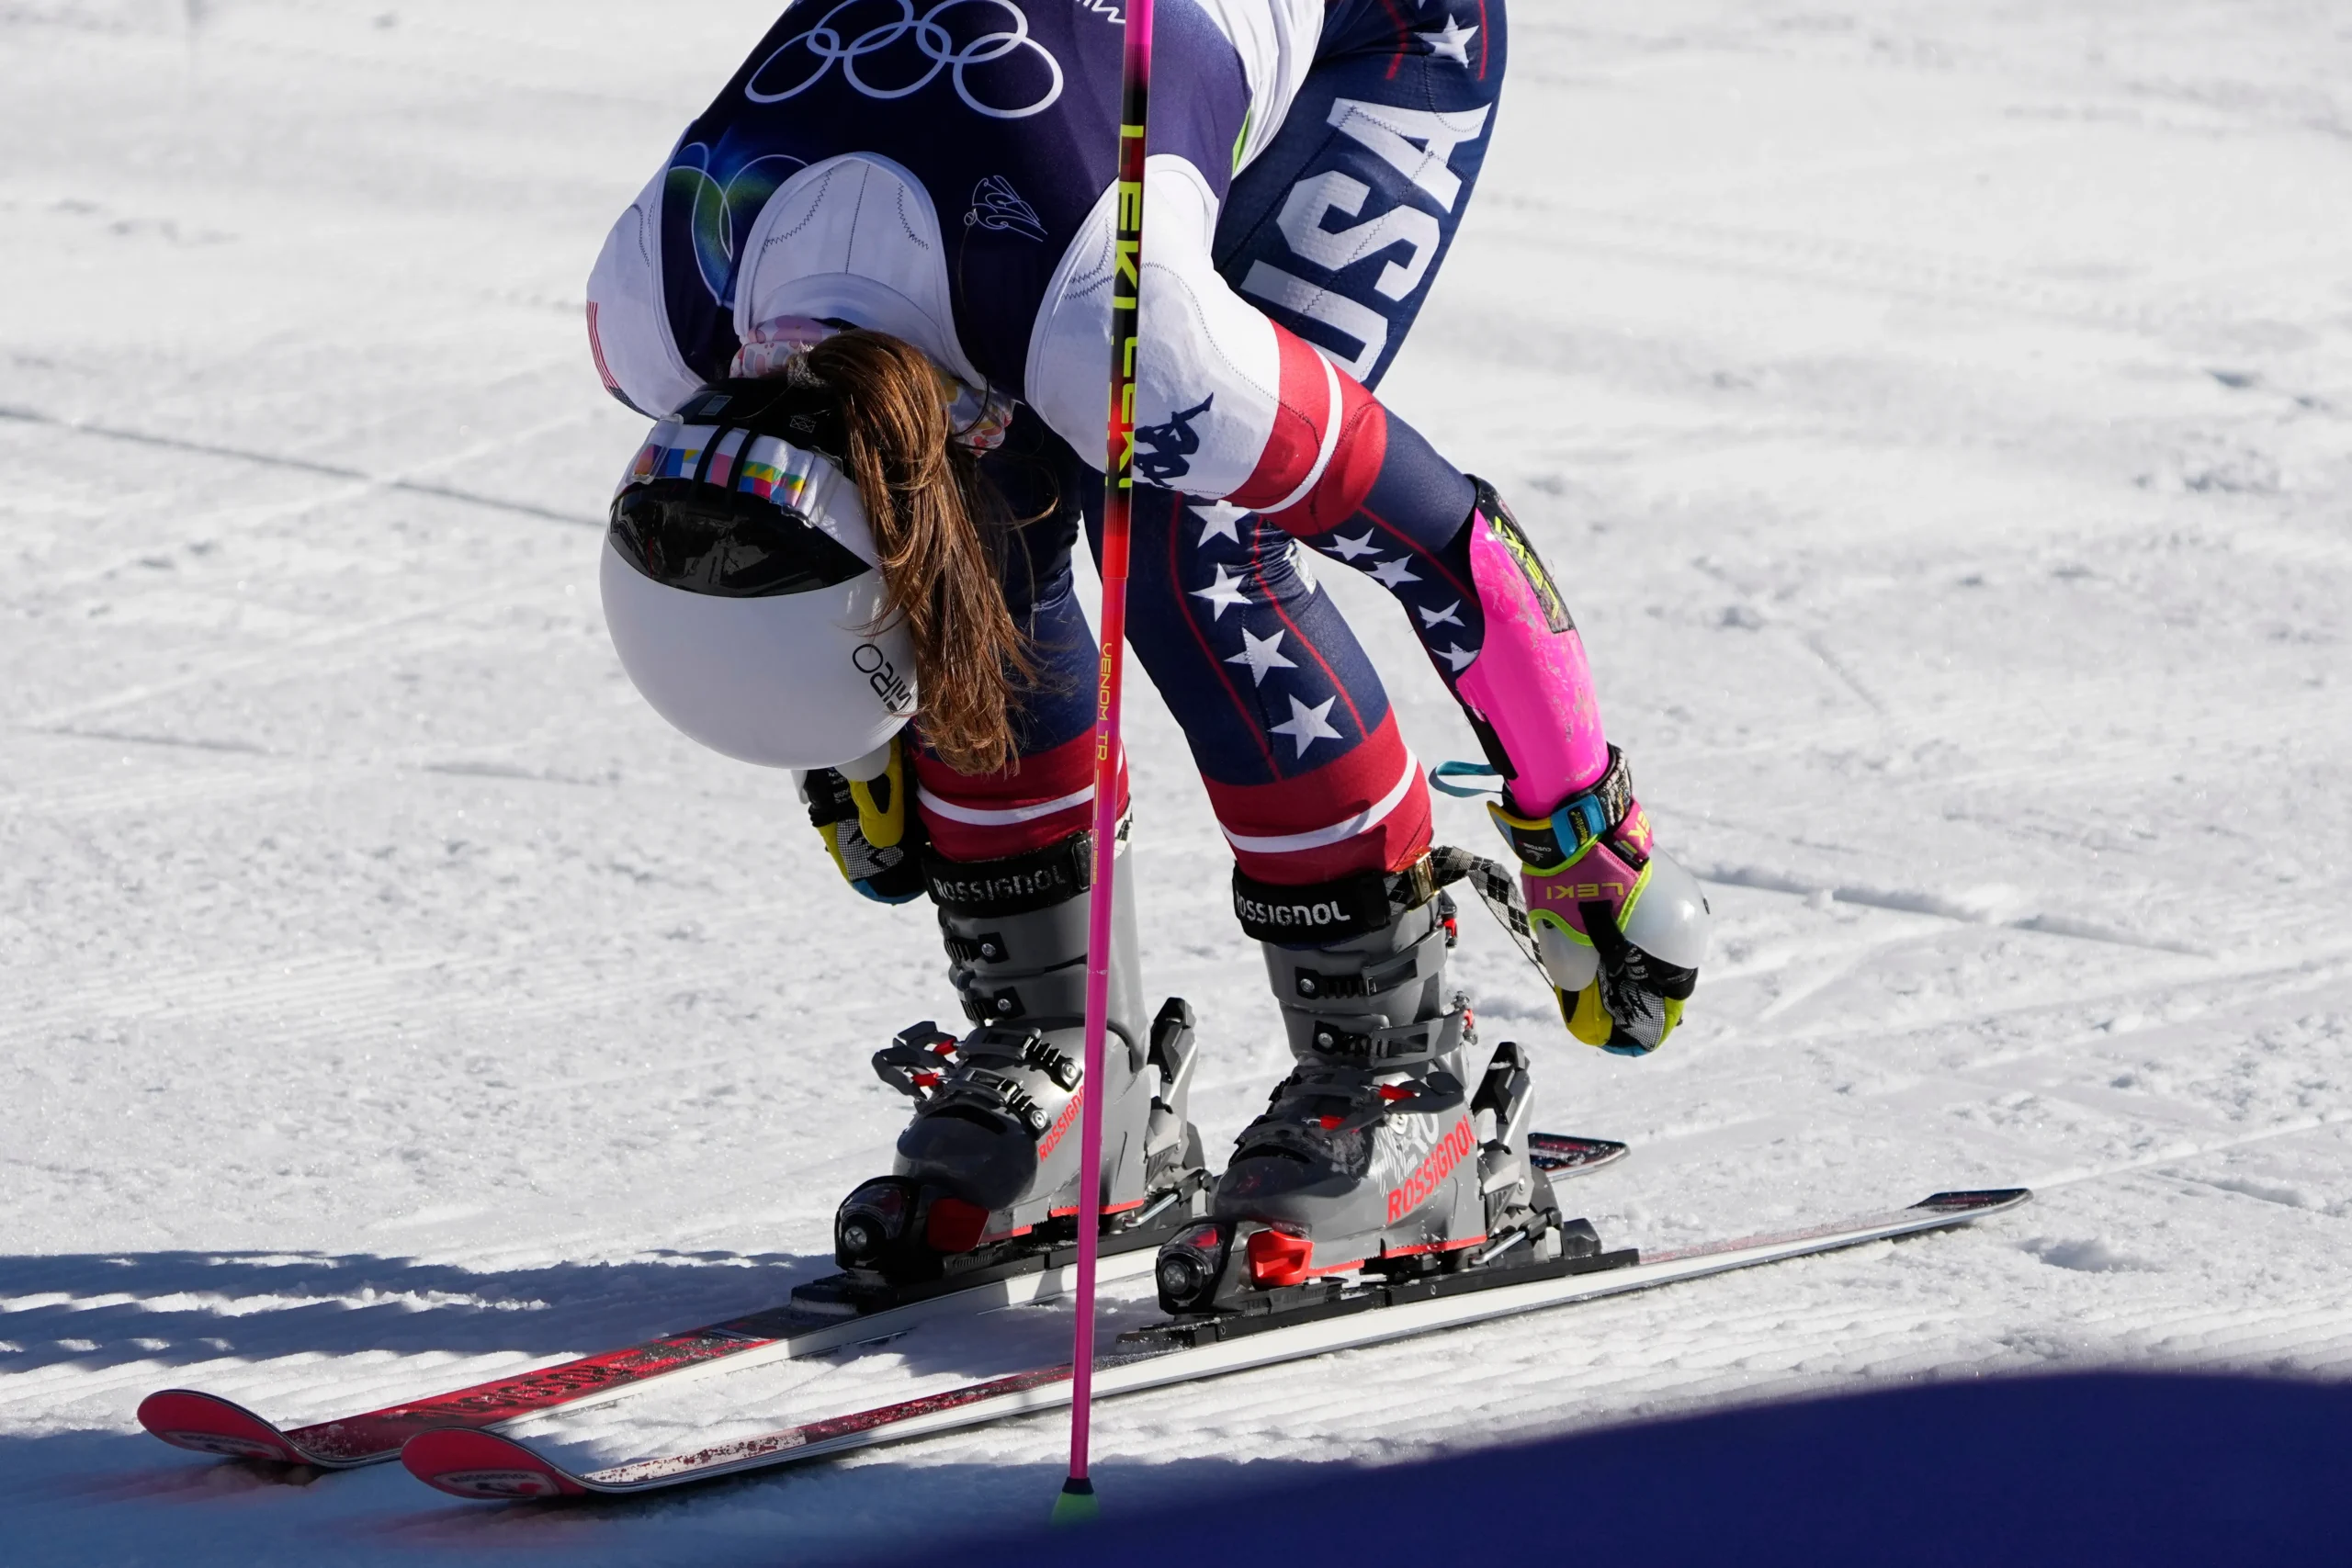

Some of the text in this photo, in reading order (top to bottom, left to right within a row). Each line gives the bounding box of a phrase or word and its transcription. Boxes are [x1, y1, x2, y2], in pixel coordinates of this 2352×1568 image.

[1113, 124, 1145, 310] LEKI
[1239, 97, 1493, 382] USA
[1494, 515, 1560, 620] LEKI
[1097, 642, 1113, 761] VENOM TR
[1620, 809, 1652, 856] EKI
[1546, 882, 1624, 900] LEKI
[1037, 1085, 1085, 1162] ROSSIGN
[1387, 1113, 1476, 1224] ROSSIGNOL
